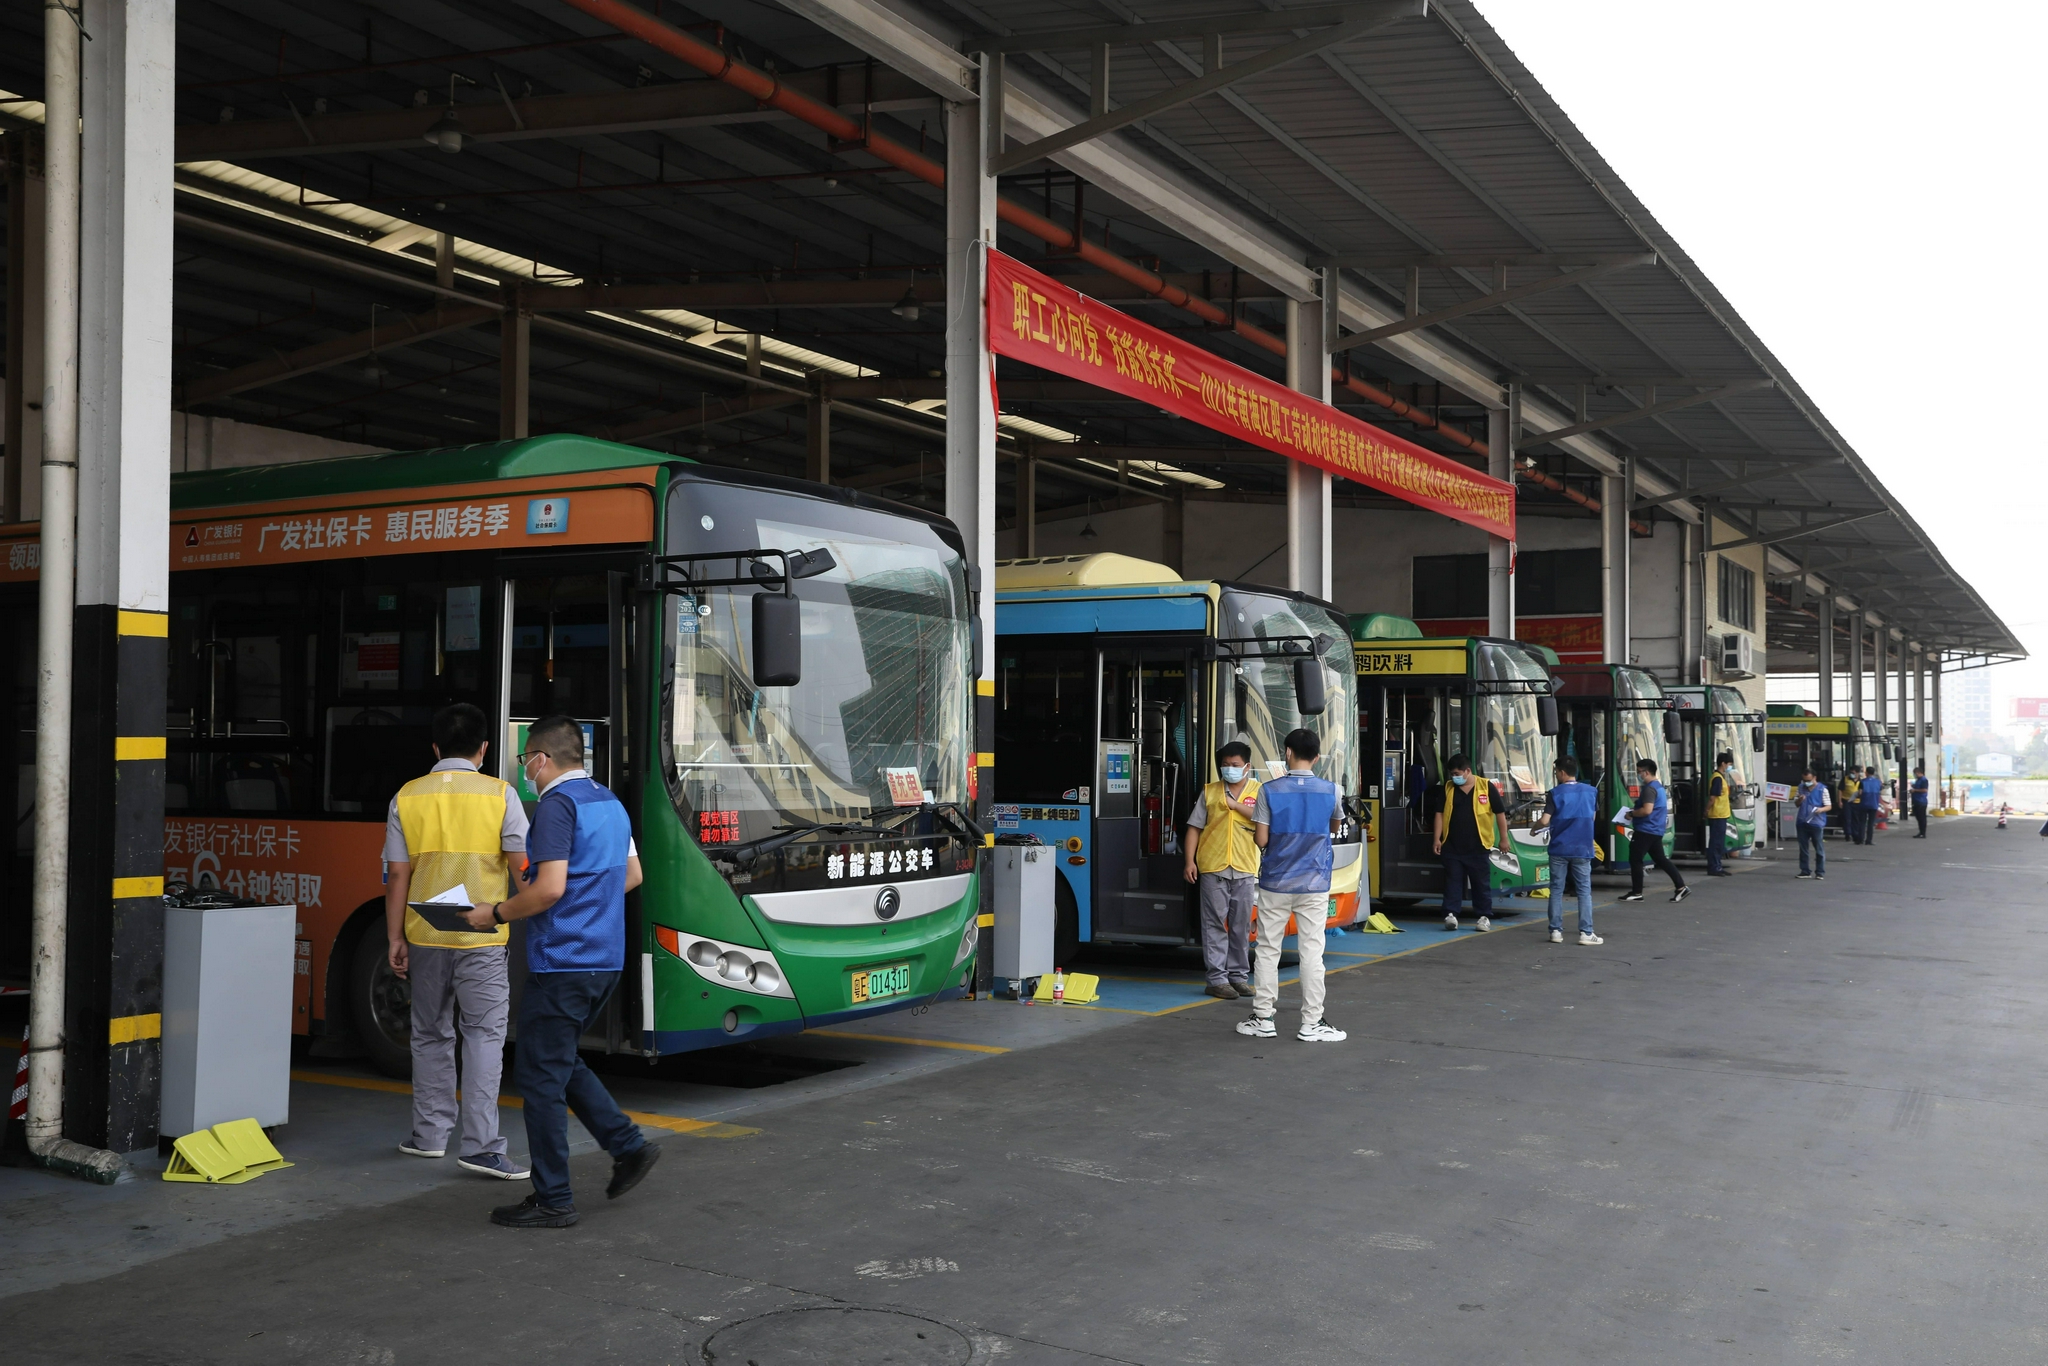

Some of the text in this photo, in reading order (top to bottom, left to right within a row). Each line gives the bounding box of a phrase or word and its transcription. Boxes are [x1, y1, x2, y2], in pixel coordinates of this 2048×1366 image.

[1012, 280, 1102, 367] 职工心向党
[204, 523, 243, 540] 广发银行
[257, 503, 510, 553] 广发社保卡 惠民服务季
[895, 771, 921, 798] 充电
[700, 810, 739, 826] 视觉盲区
[164, 821, 301, 859] 发银行社保卡
[700, 827, 740, 843] 请勿靠近
[827, 847, 934, 880] 新能源公交车
